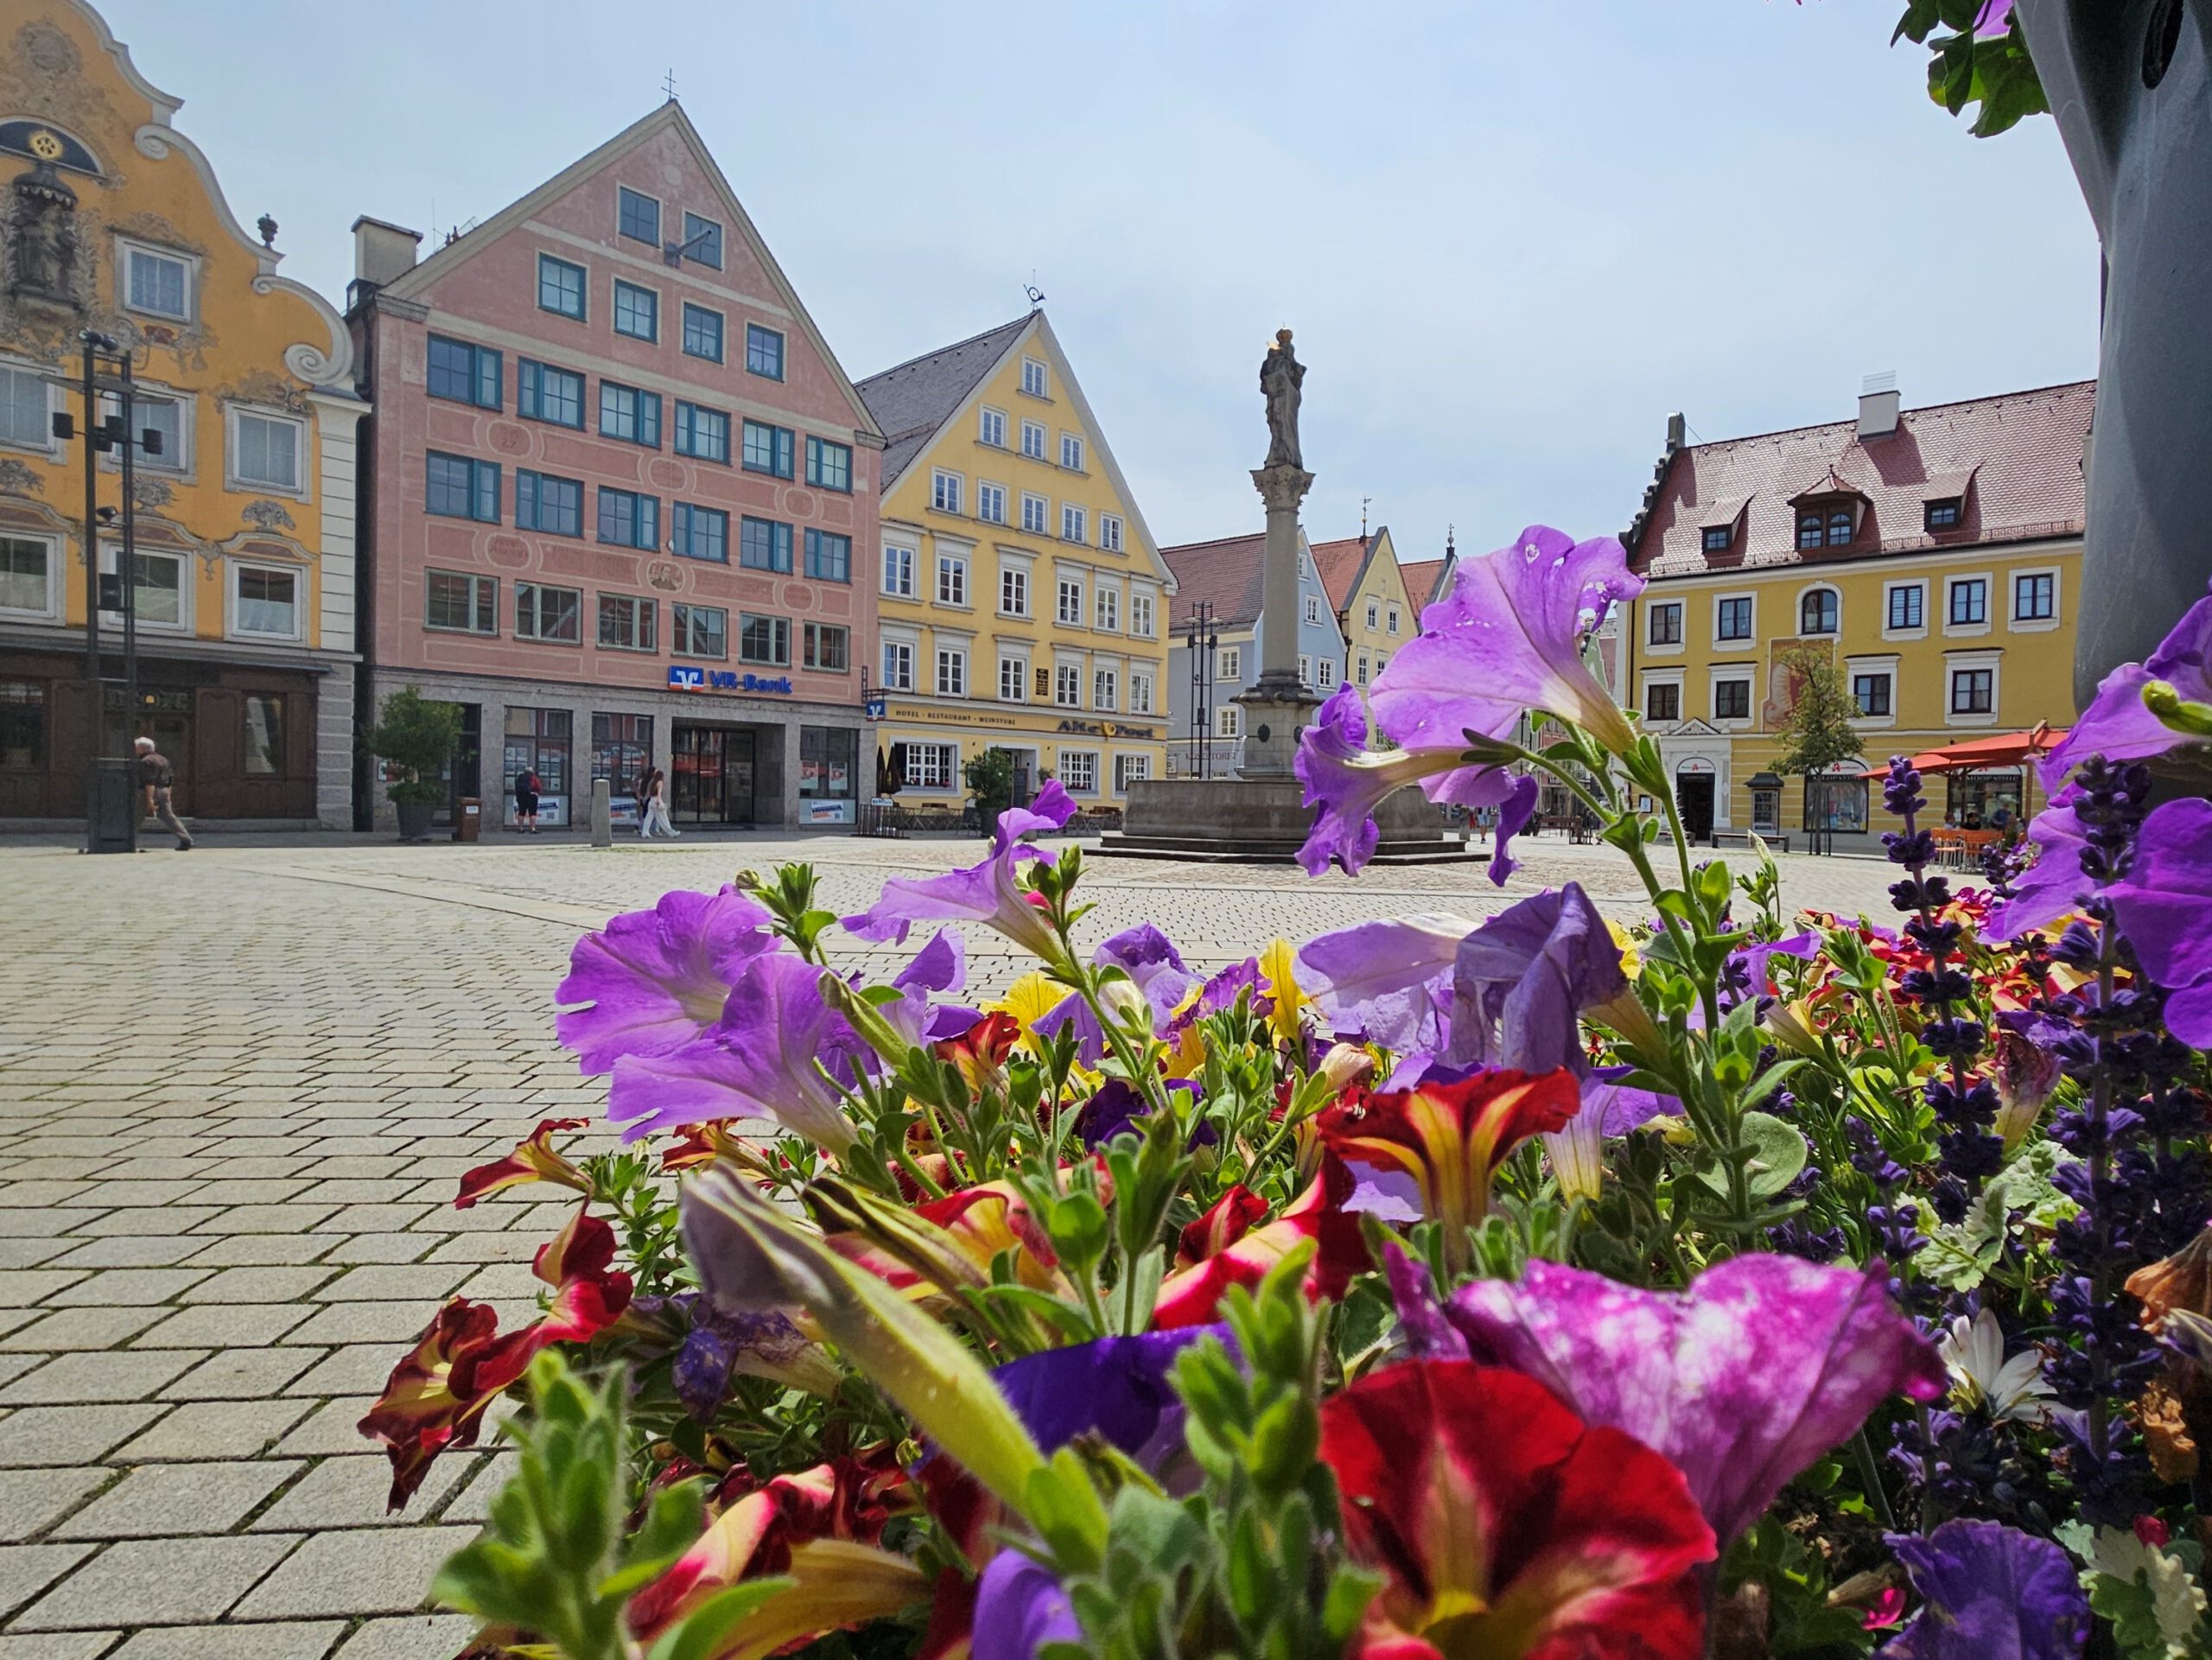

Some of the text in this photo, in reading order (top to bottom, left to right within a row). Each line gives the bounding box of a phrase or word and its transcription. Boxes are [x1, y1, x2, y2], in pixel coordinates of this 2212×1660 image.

[709, 670, 792, 694] VR-Bank
[896, 709, 1016, 726] HOTEL RESTAURANT WEINSTUBE
[1058, 720, 1154, 738] Alte Post
